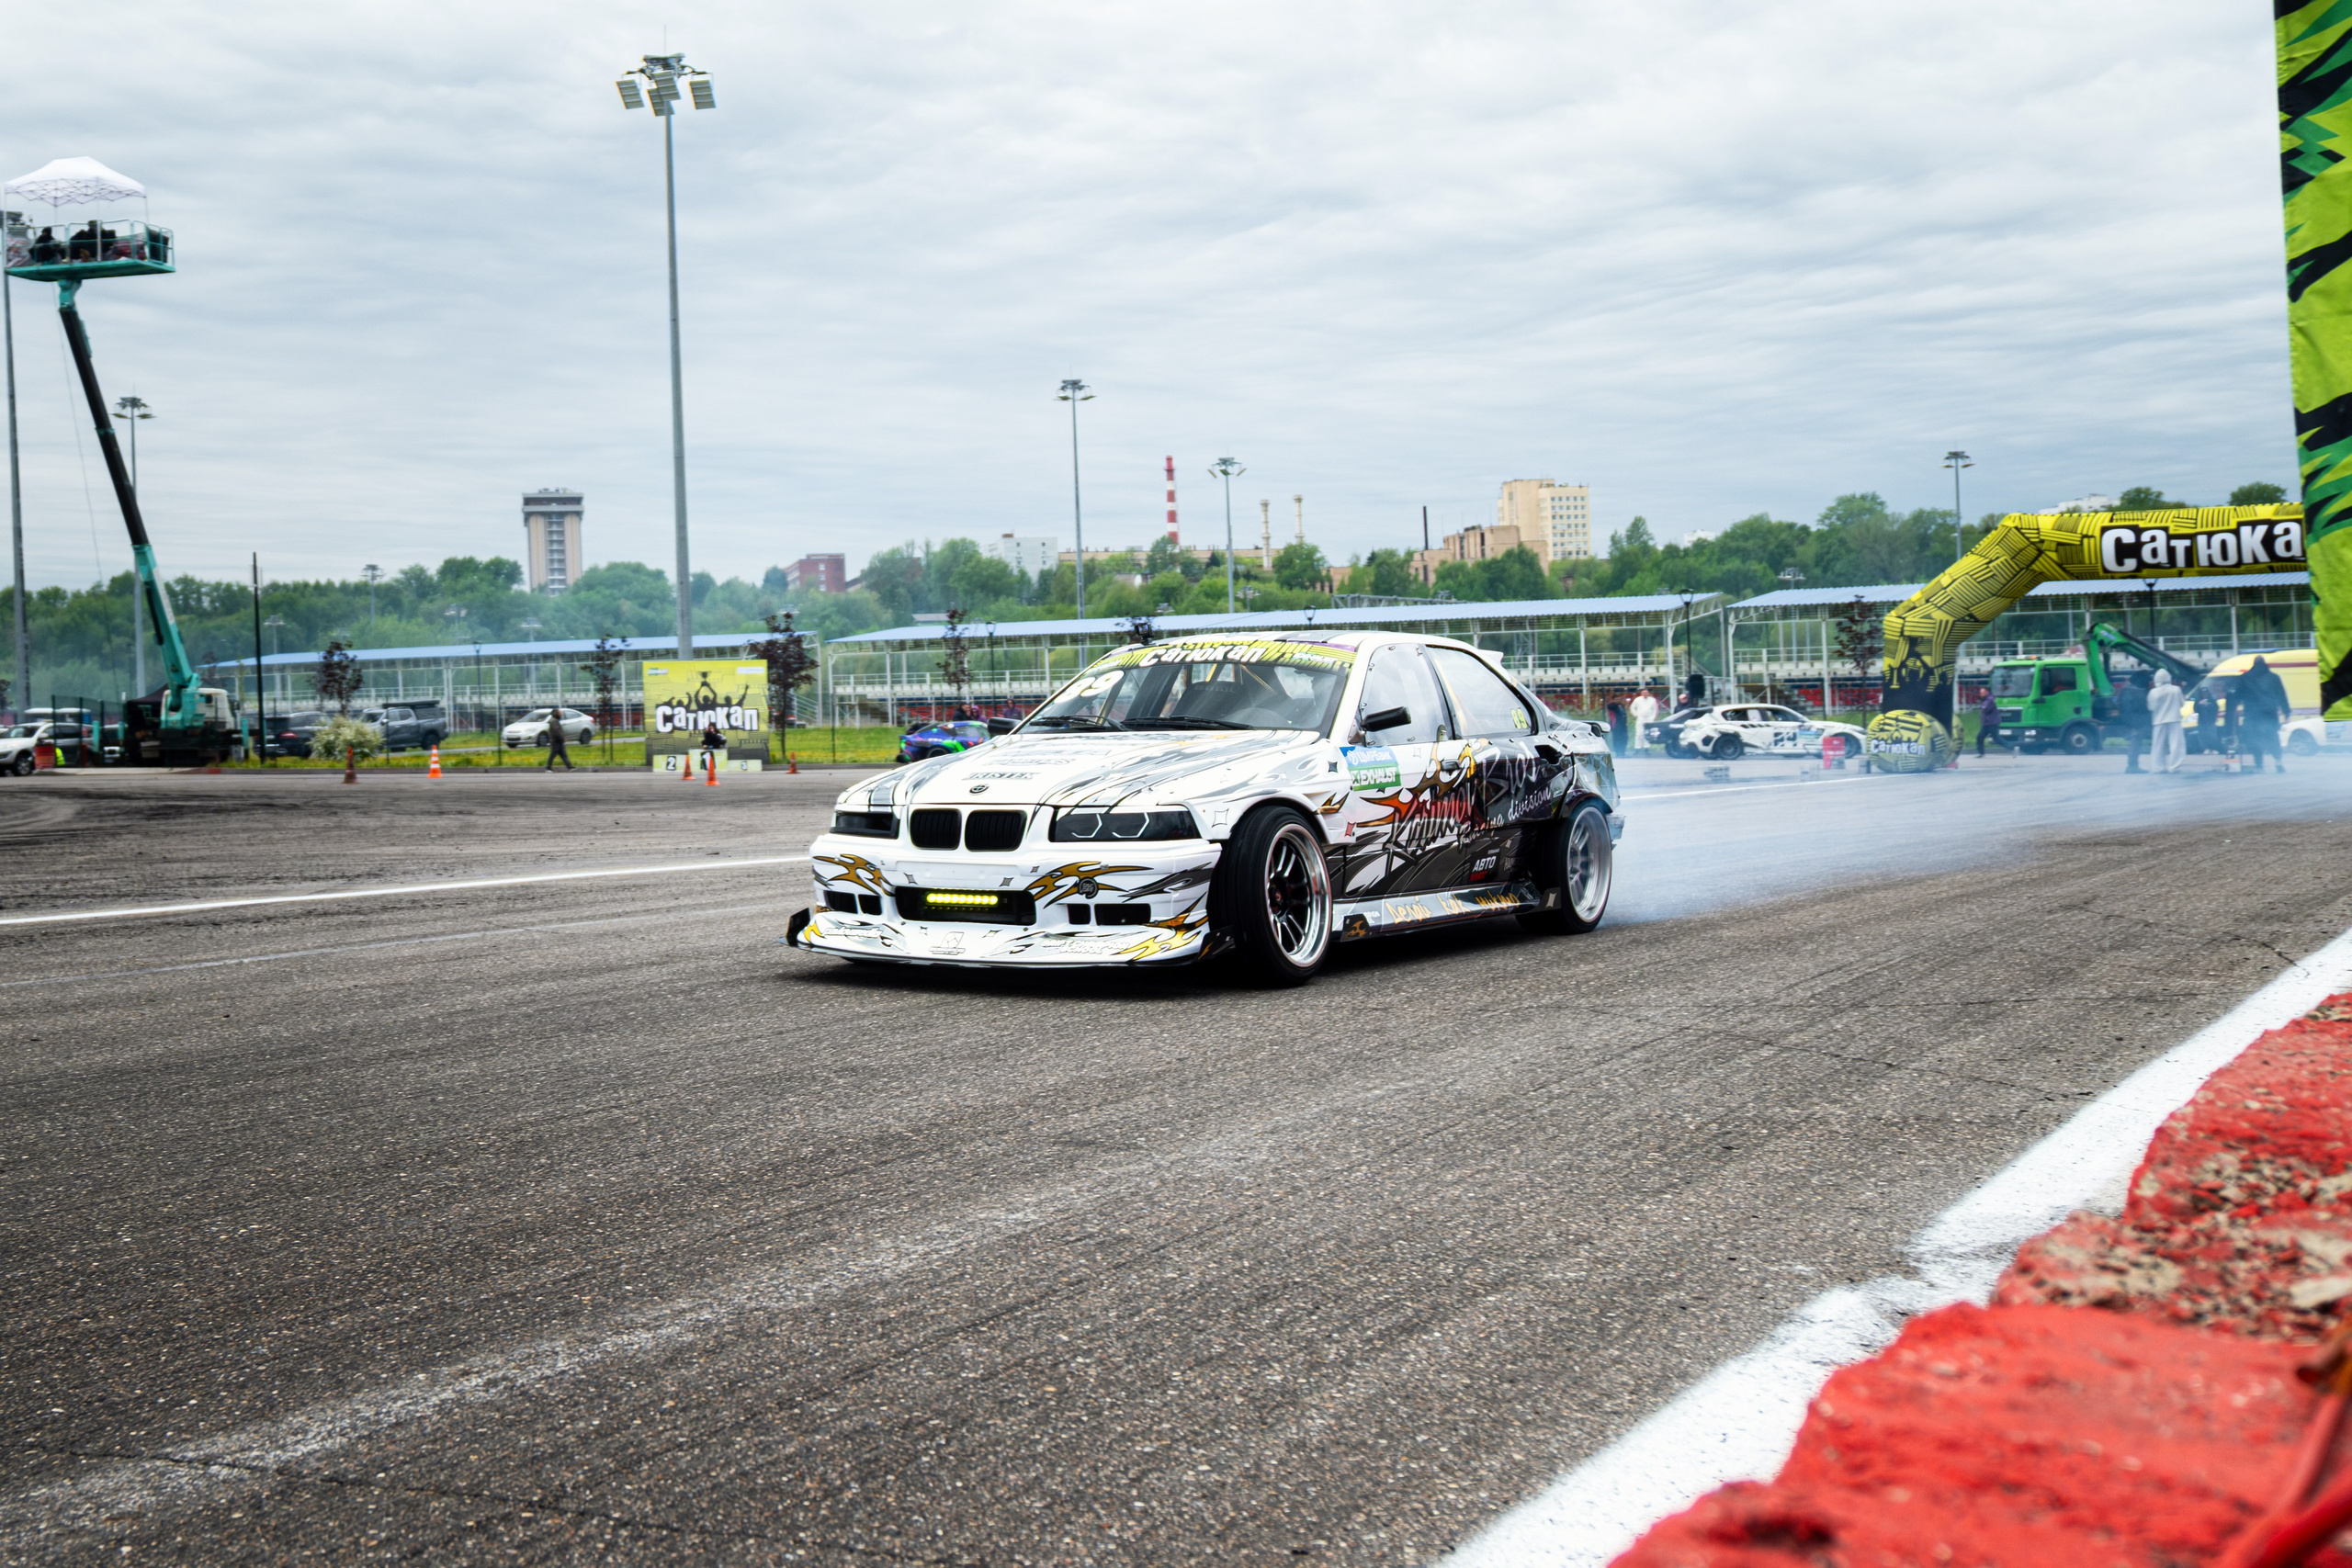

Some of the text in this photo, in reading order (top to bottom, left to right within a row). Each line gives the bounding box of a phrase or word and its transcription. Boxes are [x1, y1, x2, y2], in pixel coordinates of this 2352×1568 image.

[2100, 520, 2304, 573] Сатюка
[1510, 707, 1528, 729] 89
[667, 756, 676, 770] 2
[1508, 785, 1551, 822] division
